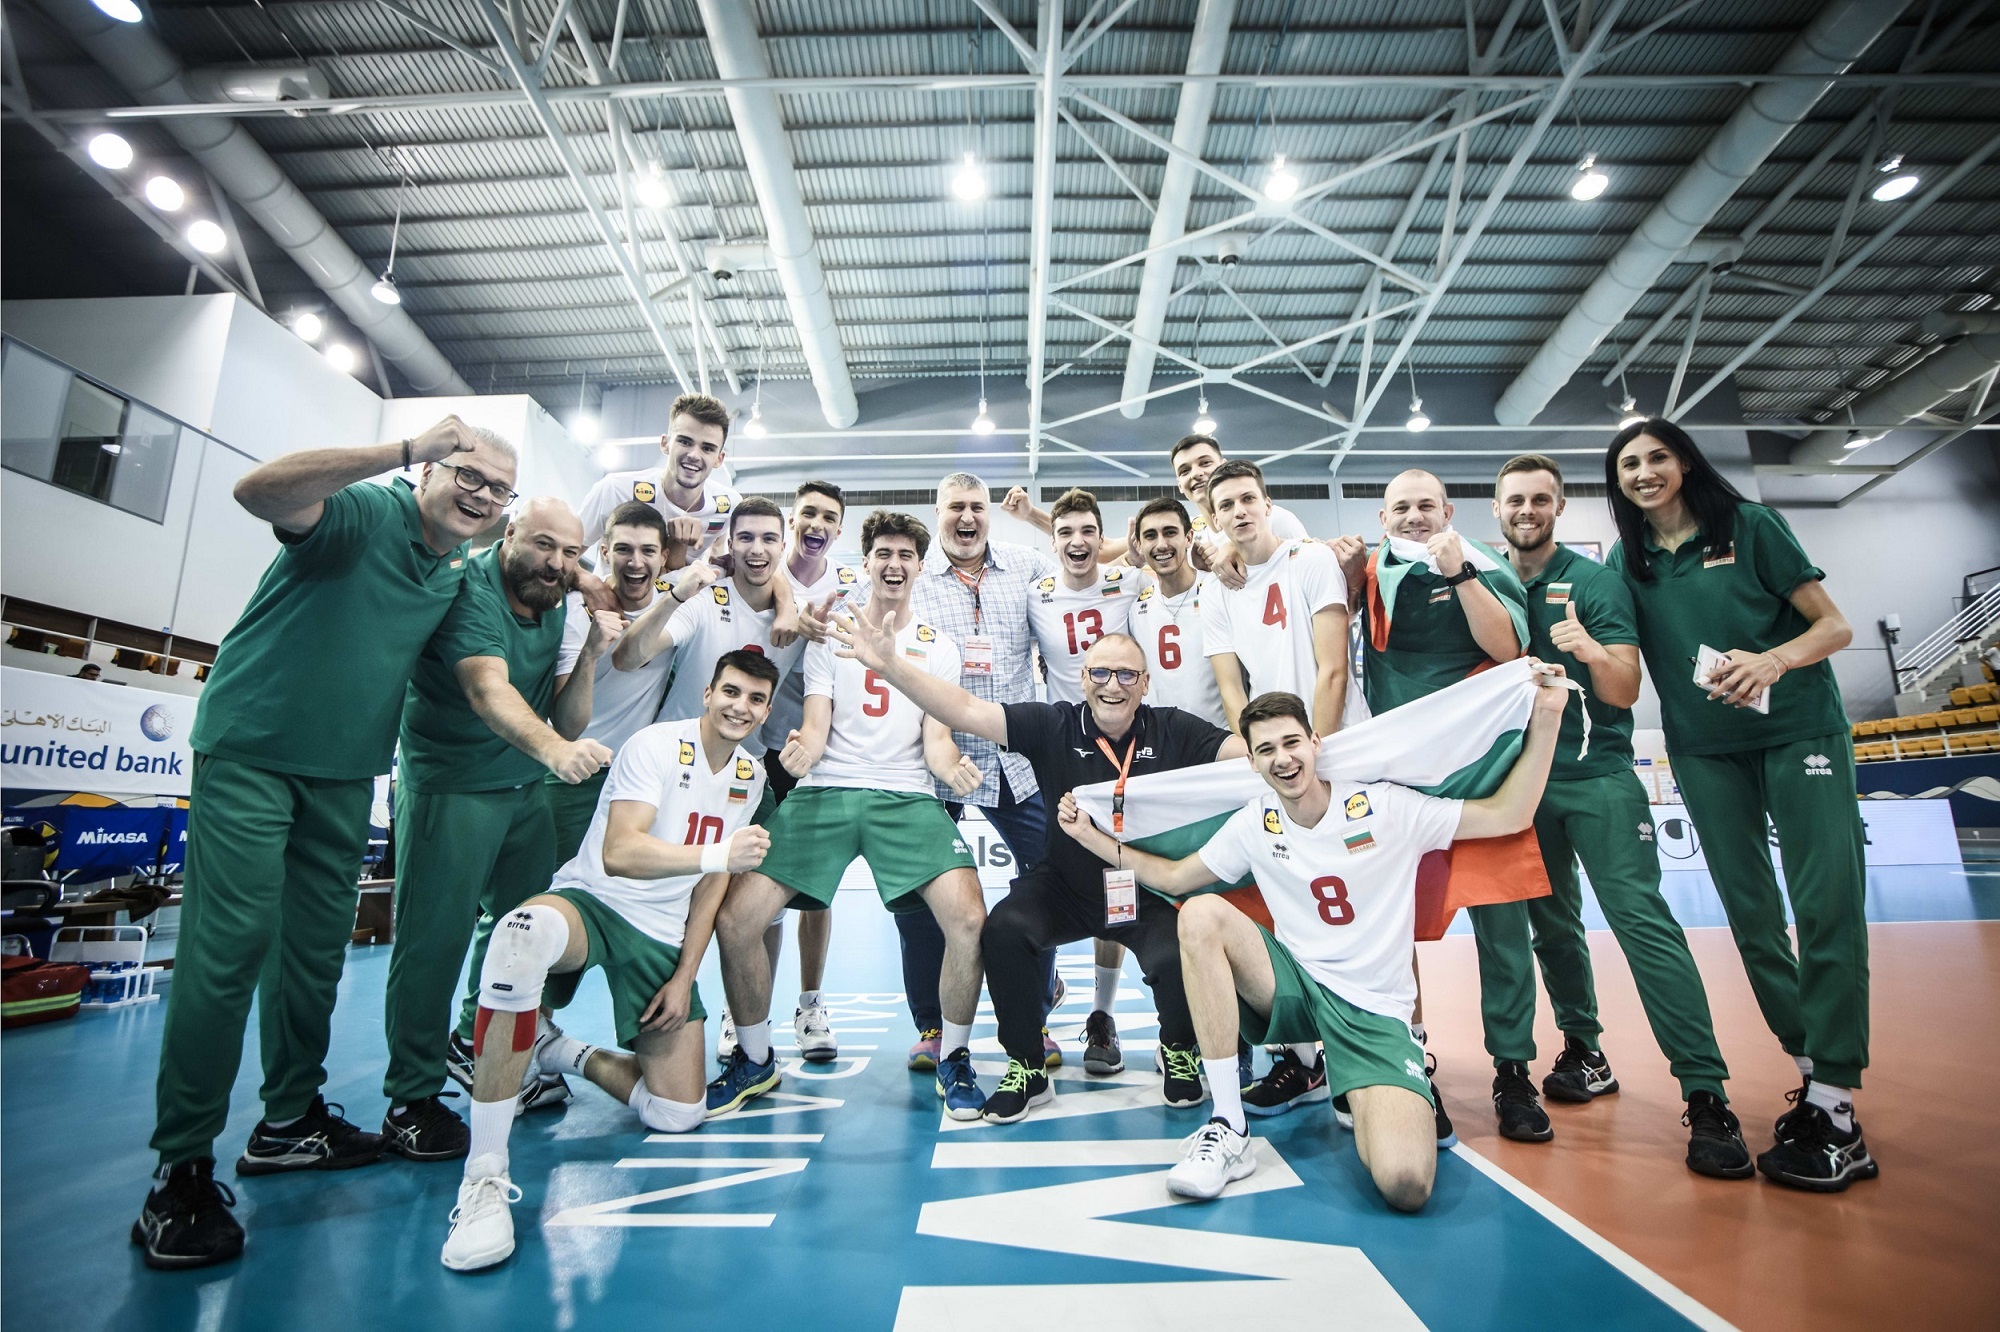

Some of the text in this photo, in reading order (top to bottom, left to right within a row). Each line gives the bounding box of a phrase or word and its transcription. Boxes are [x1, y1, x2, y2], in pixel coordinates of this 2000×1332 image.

[1262, 582, 1287, 630] 4
[1063, 609, 1104, 655] 13
[1158, 624, 1182, 670] 6
[862, 669, 890, 717] 5
[1, 740, 183, 776] united bank
[1805, 768, 1833, 776] errea
[684, 812, 724, 845] 10
[1349, 842, 1377, 855] BULGARIA
[1310, 876, 1355, 926] 8
[507, 921, 531, 931] errea
